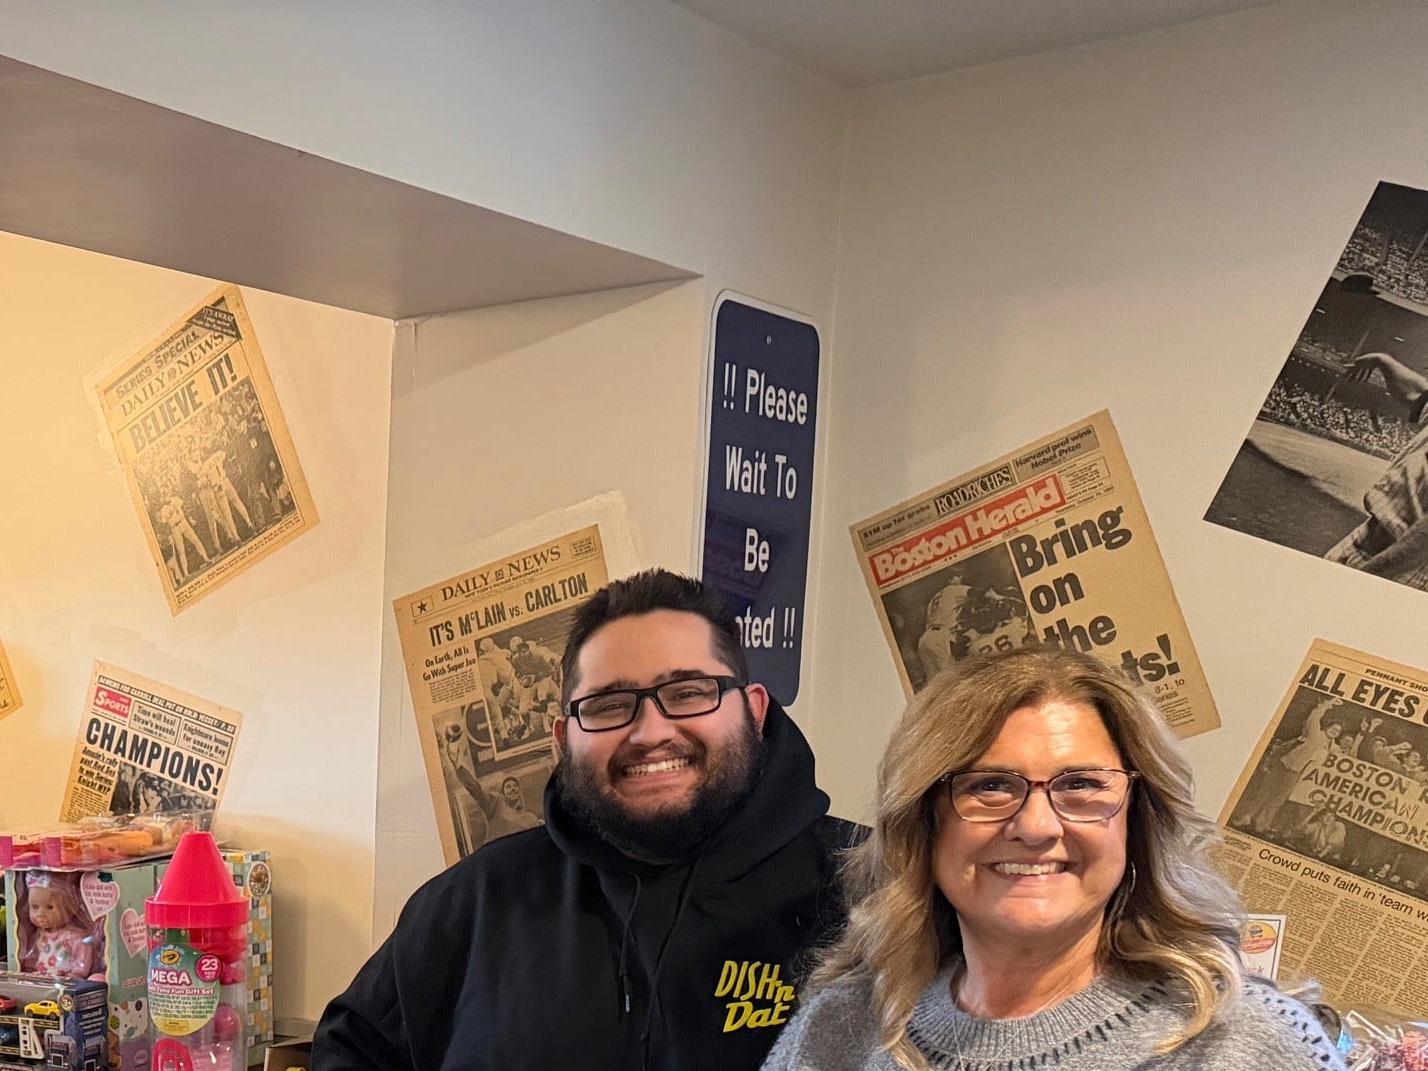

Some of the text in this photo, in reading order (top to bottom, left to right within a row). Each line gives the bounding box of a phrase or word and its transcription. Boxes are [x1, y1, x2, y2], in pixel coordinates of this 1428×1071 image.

[115, 330, 200, 398] SERIES SPECIAL
[121, 332, 224, 417] DAILY NEWS
[129, 353, 238, 453] BELIEVE IT!
[722, 361, 809, 425] !! Please
[1015, 428, 1093, 468] Harvard prof wins
[1031, 442, 1082, 470] Nobel Prize
[725, 444, 797, 500] Wait To
[745, 527, 770, 573] Be
[873, 524, 967, 580] Boston
[967, 479, 1059, 540] Herald
[1010, 505, 1132, 578] Bring
[441, 571, 491, 602] DAILY
[508, 546, 562, 576] NEWS
[1029, 572, 1085, 614] on
[429, 620, 455, 647] IT'S
[524, 572, 589, 613] CARLTON
[783, 607, 796, 651] !!
[1042, 615, 1117, 653] the
[423, 657, 476, 682] Go With Super Joe
[425, 647, 464, 668] On Earth, All
[1365, 667, 1407, 687] PENNANT
[95, 690, 130, 714] SPORTS
[1299, 663, 1421, 718] ALL EYES
[86, 718, 223, 795] CHAMPIONS!
[1323, 752, 1408, 796] BOSTON
[1302, 769, 1419, 820] AMERICAN
[1258, 848, 1413, 915] Crowd puts faith in 'team
[151, 969, 191, 986] MEGA
[200, 958, 219, 971] 23
[714, 960, 780, 1001] DISH
[171, 987, 201, 995] Fun Gift
[723, 1001, 790, 1033] Dat
